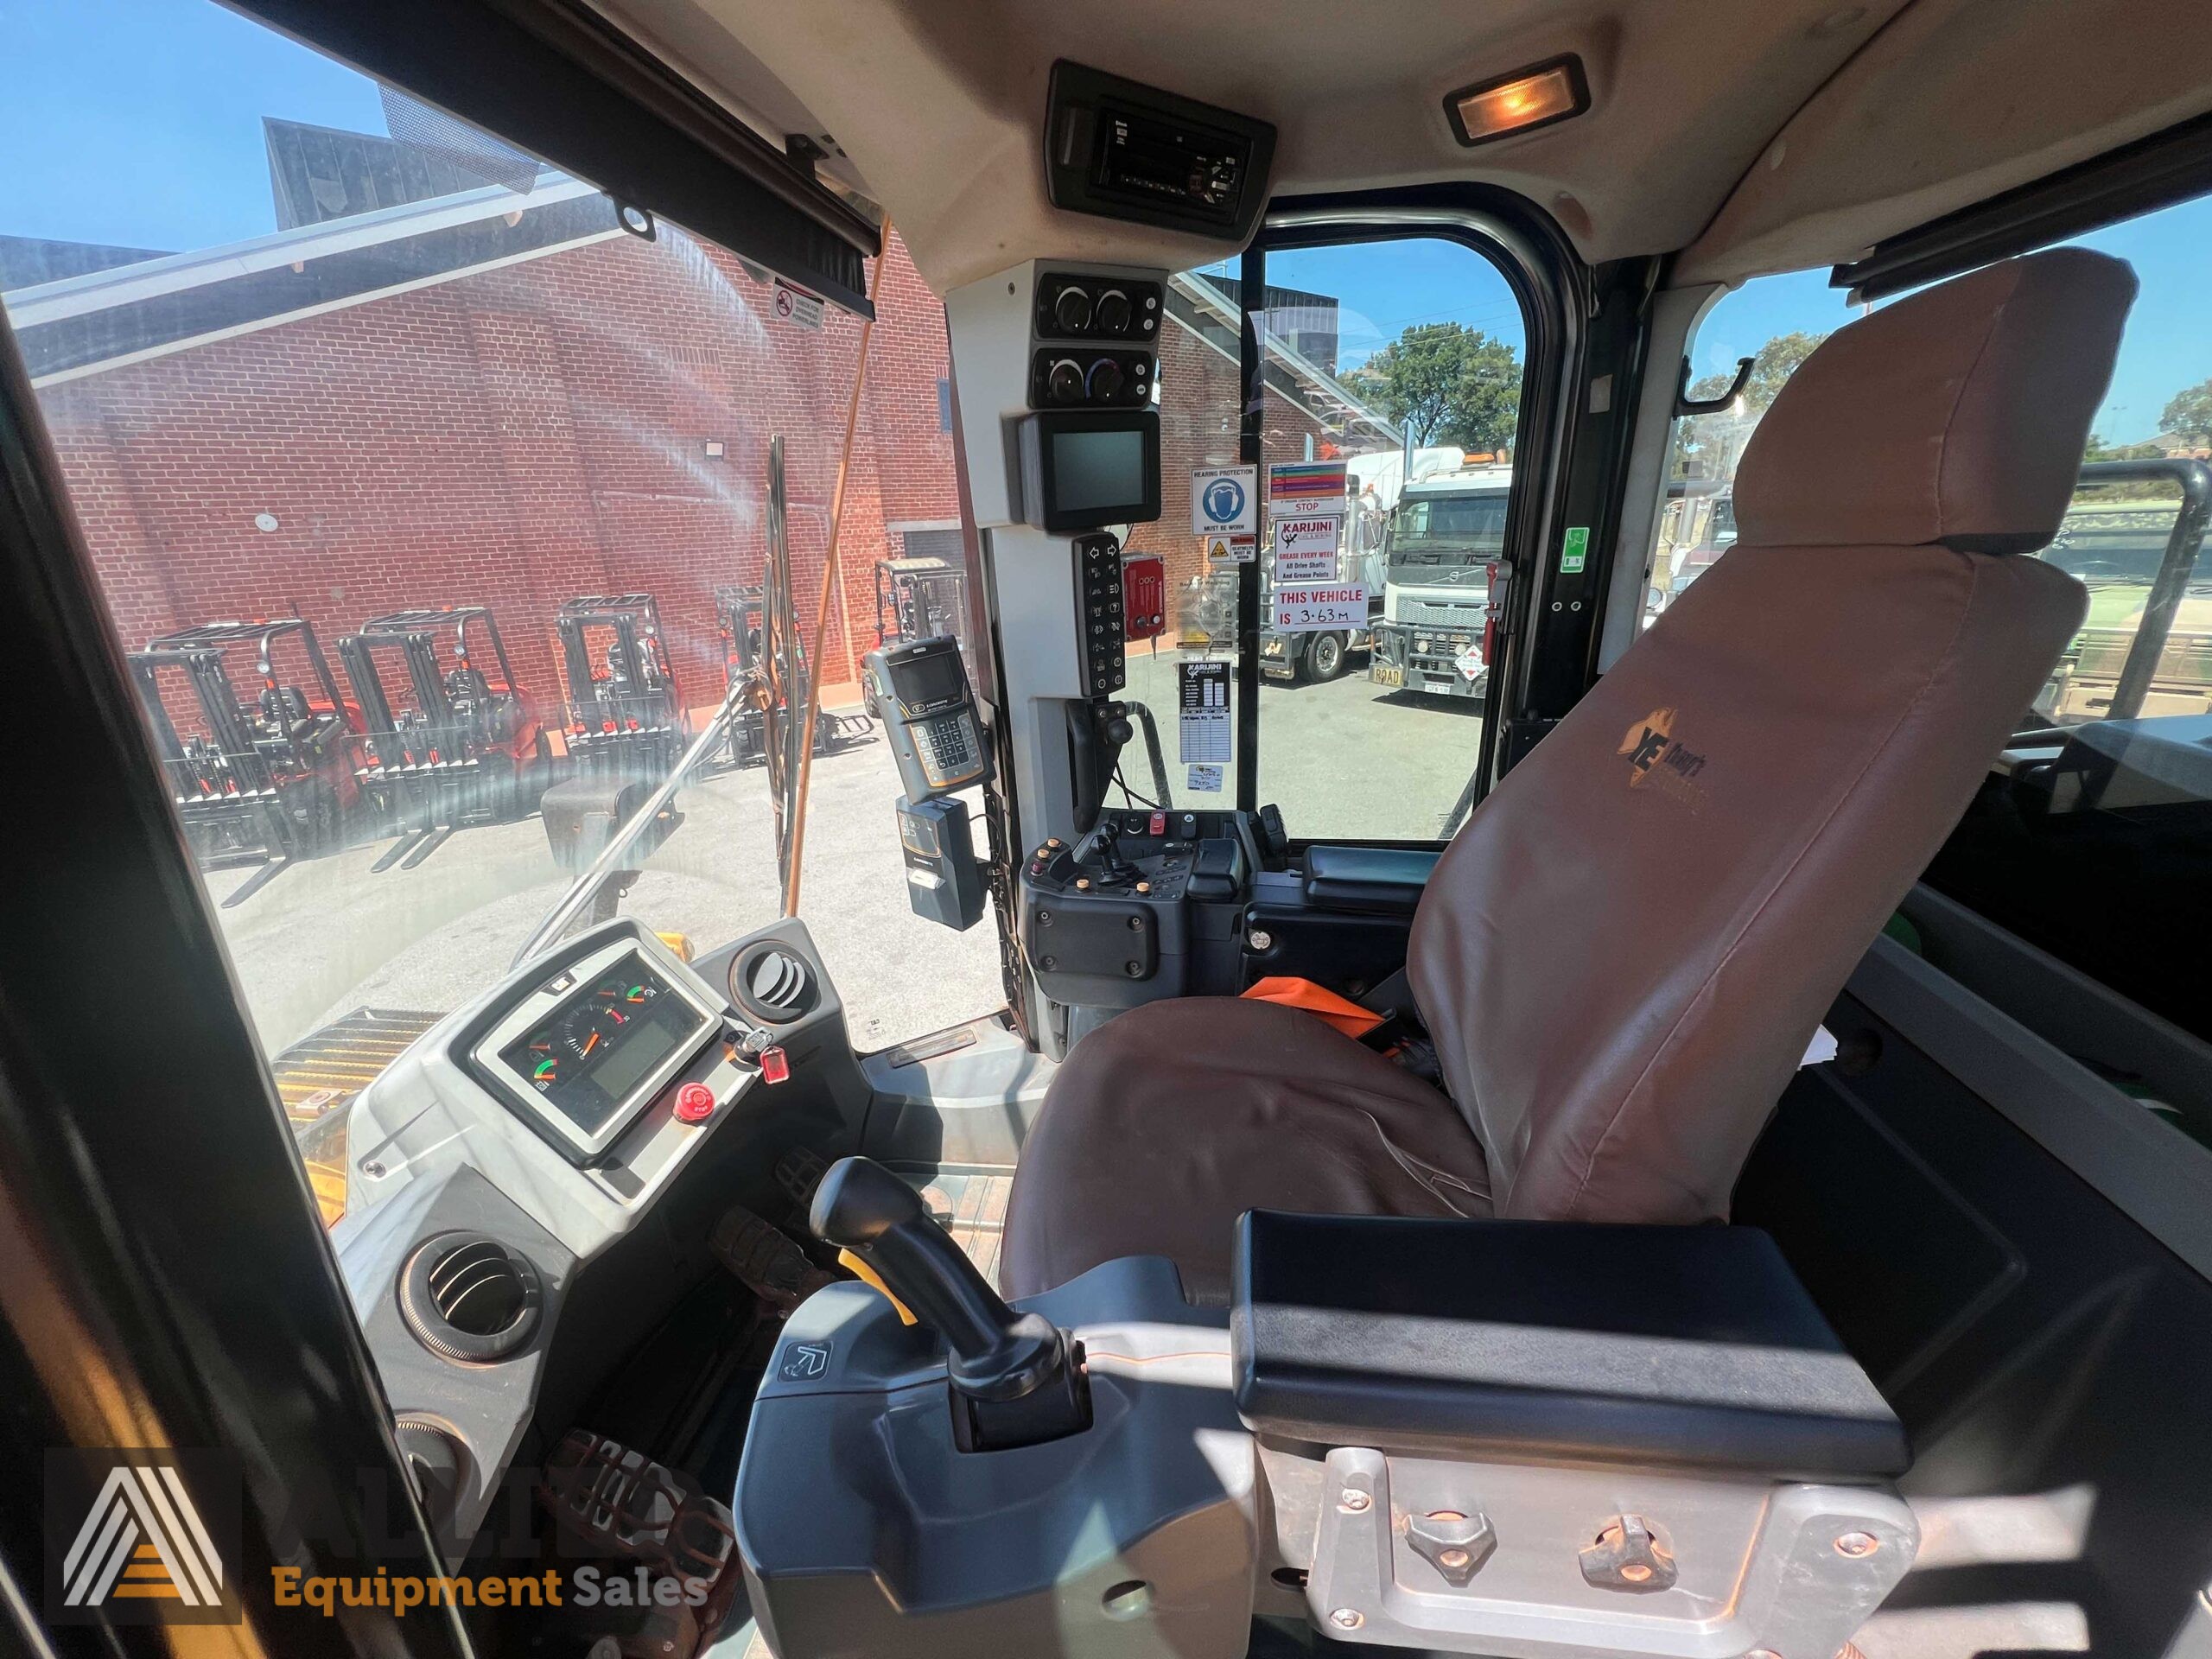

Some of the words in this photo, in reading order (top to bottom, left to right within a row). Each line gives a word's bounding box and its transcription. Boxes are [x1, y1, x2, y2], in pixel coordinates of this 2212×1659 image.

[1219, 468, 1254, 477] PROTECTION
[1295, 502, 1319, 512] STOP
[1283, 521, 1332, 533] KARIJINI
[1280, 591, 1307, 604] THIS
[1311, 589, 1363, 603] VEHICLE
[1280, 613, 1291, 625] IS
[1376, 668, 1399, 683] ROAD
